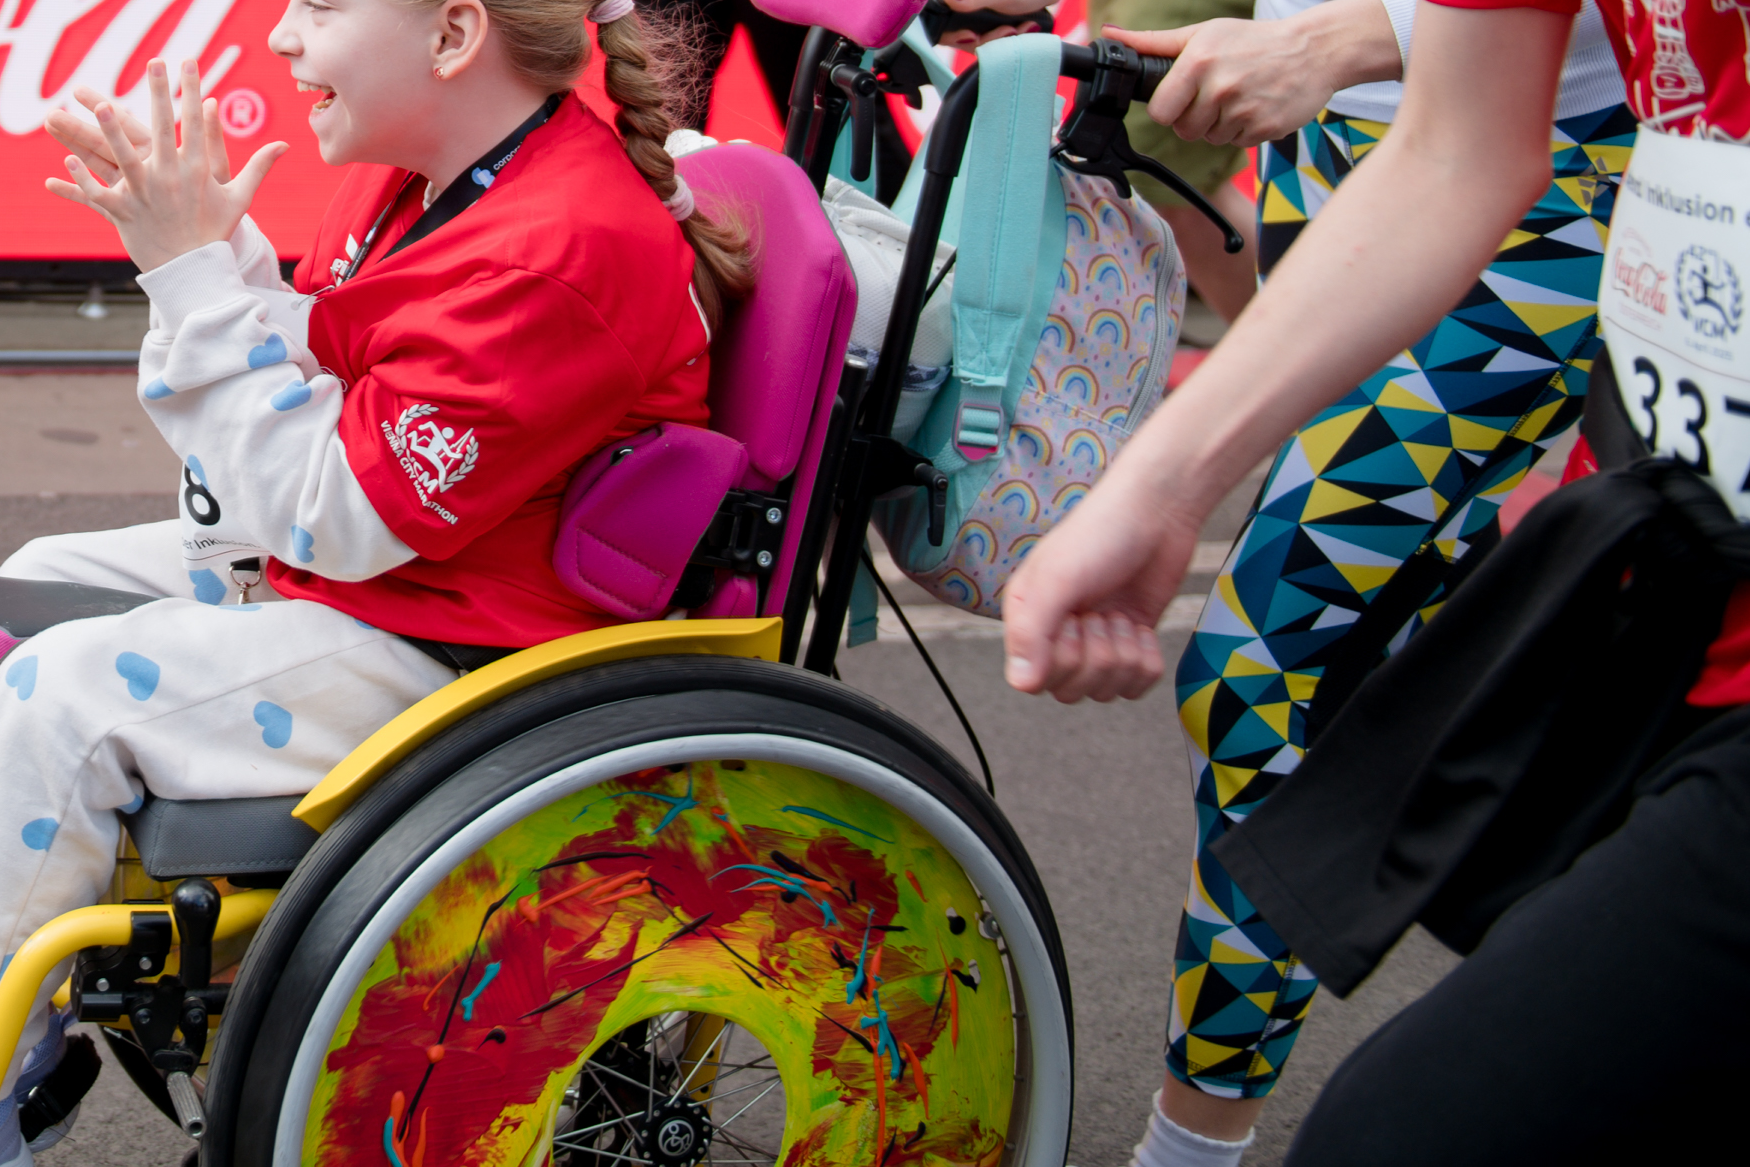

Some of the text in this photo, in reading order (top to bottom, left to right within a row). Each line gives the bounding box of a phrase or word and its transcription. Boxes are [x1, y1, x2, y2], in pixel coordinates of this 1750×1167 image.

[380, 420, 459, 526] VIENNA CITY MARATHON
